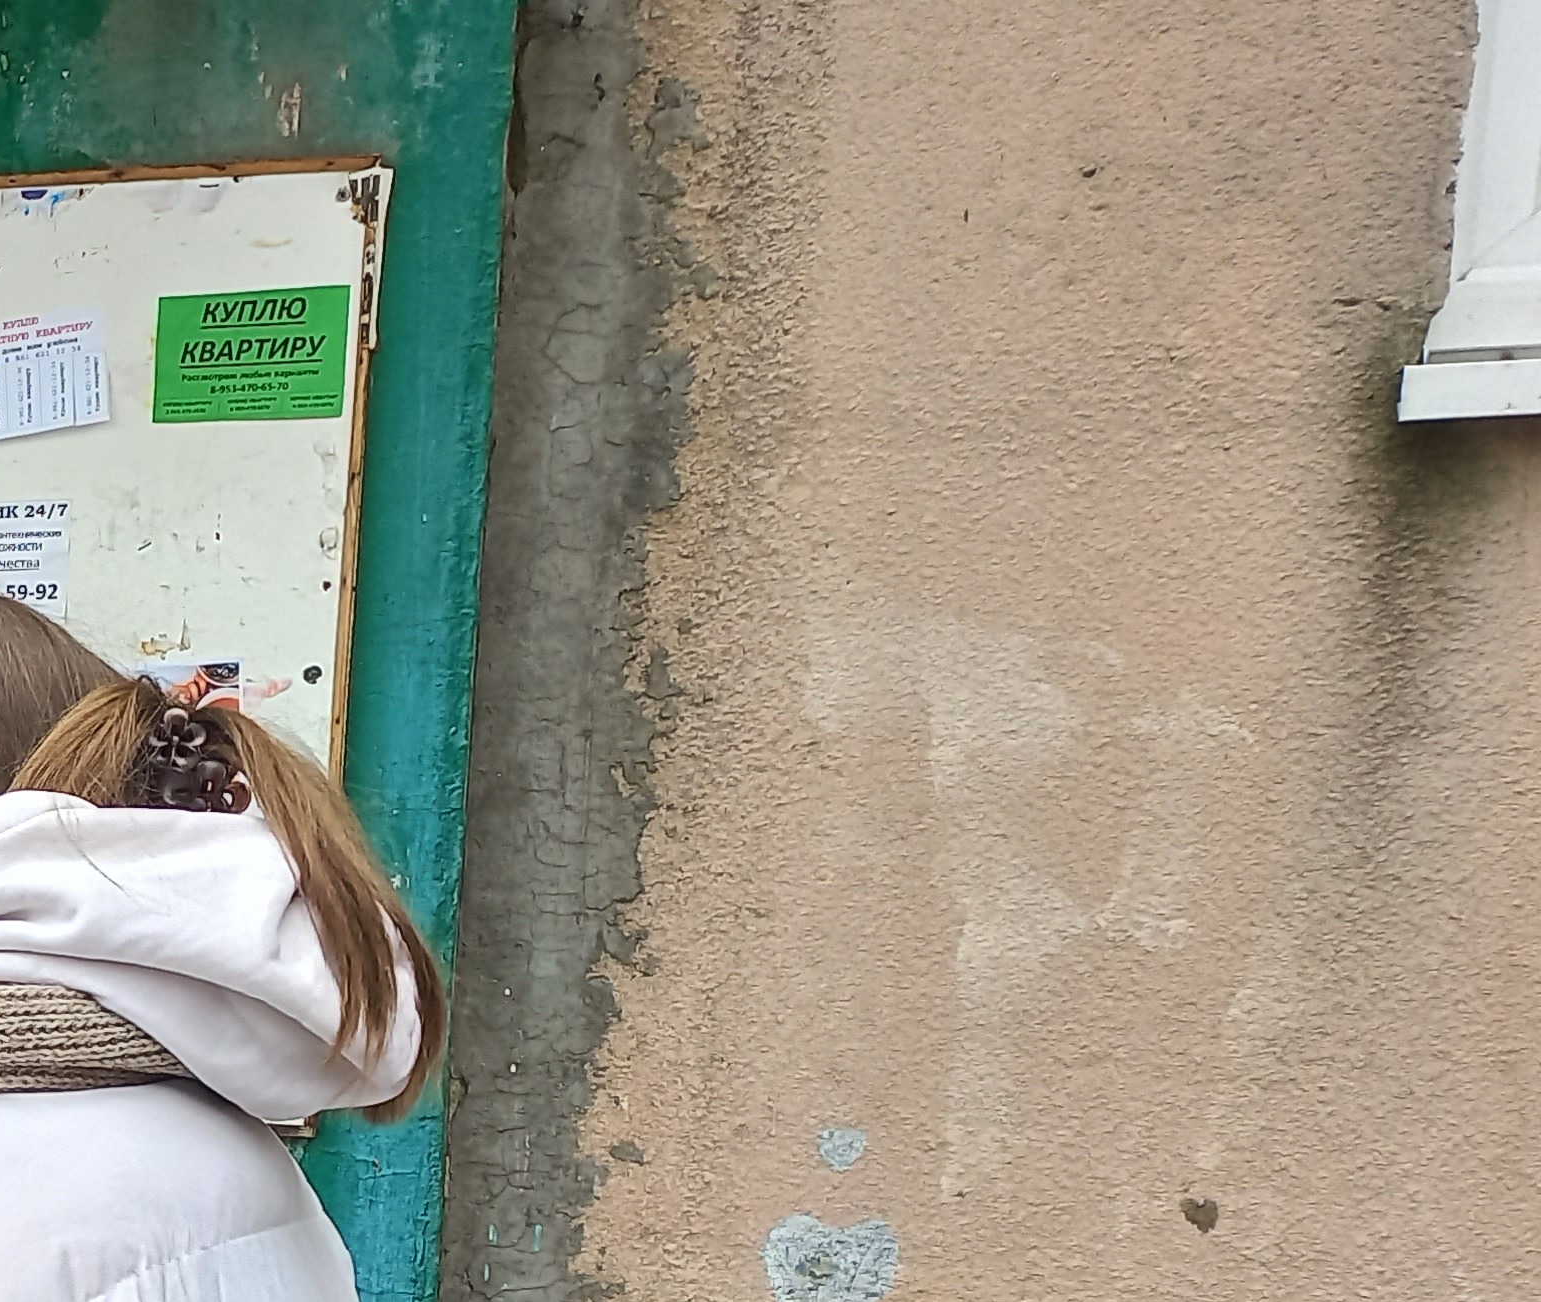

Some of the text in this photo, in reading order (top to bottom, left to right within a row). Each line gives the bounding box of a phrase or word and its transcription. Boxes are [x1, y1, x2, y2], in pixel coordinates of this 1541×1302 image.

[200, 297, 307, 325] КУПЛЮ
[35, 320, 94, 338] КВАРТИРУ
[179, 334, 327, 365] КВАРТИРУ
[24, 503, 69, 520] 24/7
